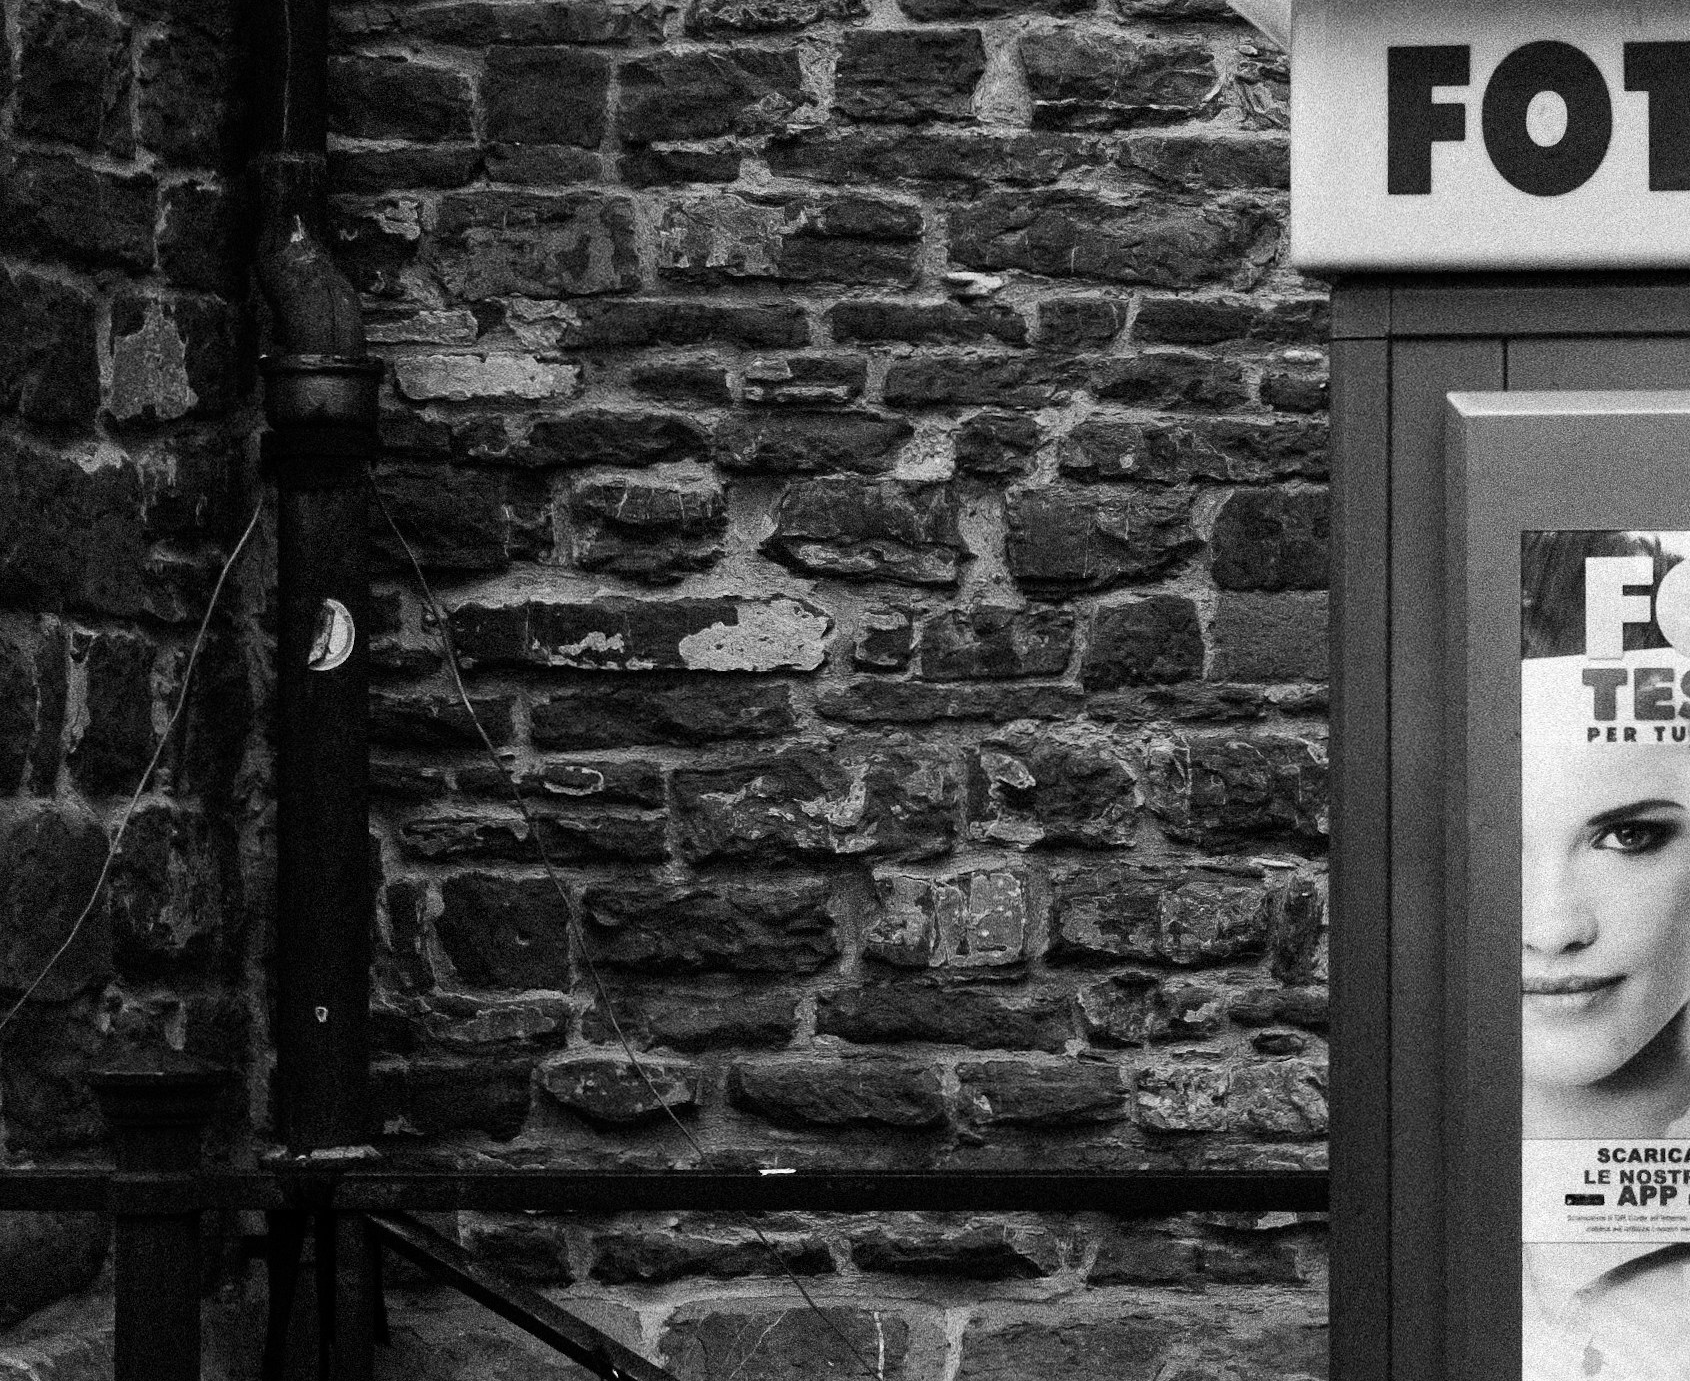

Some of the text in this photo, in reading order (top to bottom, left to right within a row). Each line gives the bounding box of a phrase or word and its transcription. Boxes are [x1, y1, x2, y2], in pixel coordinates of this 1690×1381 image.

[1587, 726, 1637, 742] PER
[1584, 1169, 1611, 1185] LE
[1617, 1185, 1678, 1206] APP
